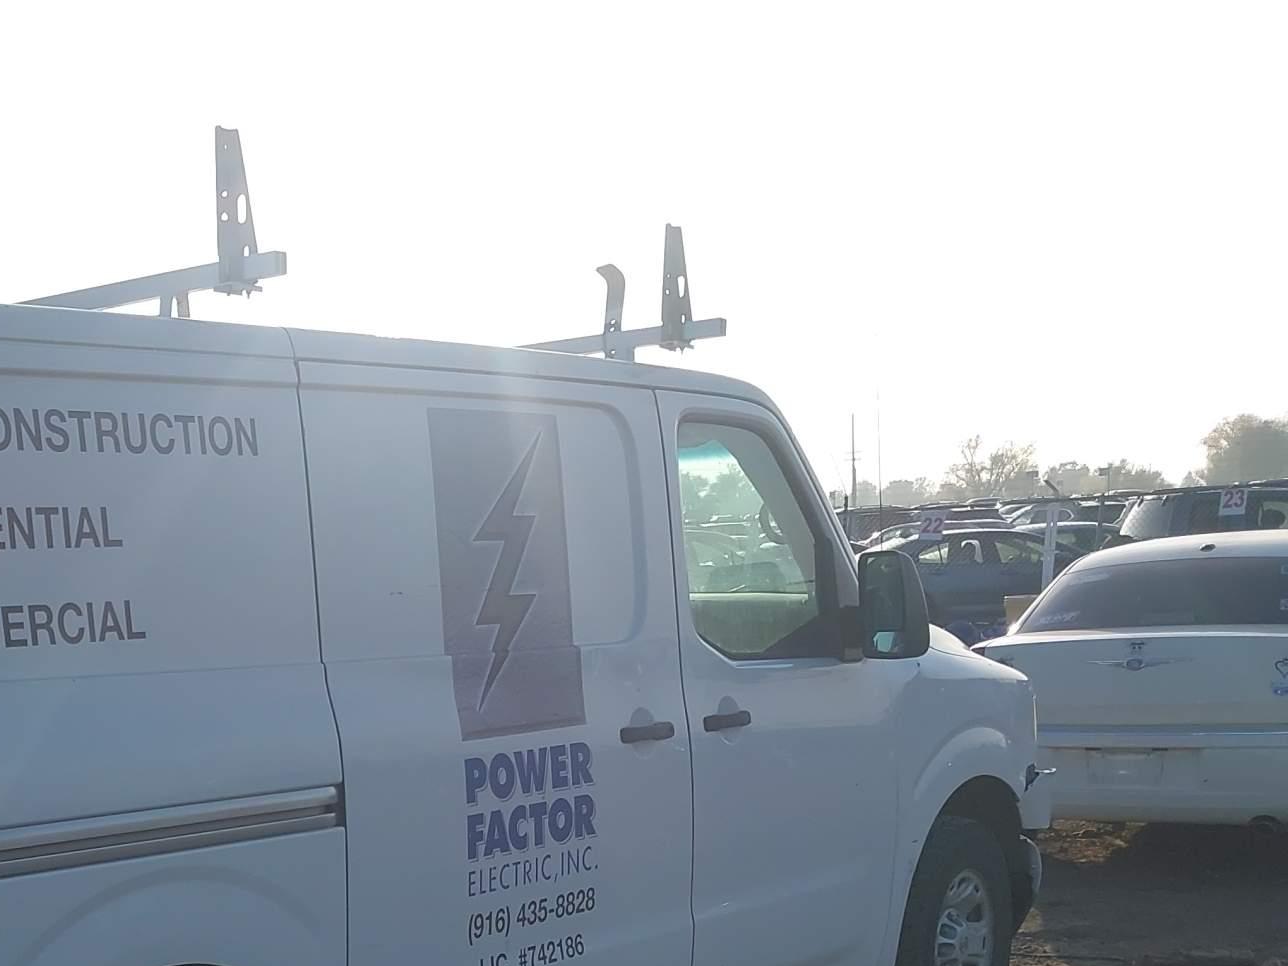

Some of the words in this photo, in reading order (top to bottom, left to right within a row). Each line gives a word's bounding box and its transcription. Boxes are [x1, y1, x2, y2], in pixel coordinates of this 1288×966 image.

[922, 517, 943, 533] 22
[1223, 488, 1245, 508] 23
[463, 742, 596, 806] POWER
[466, 794, 598, 862] FACTOR
[468, 905, 511, 946] (916)
[516, 887, 596, 928] 435-8828
